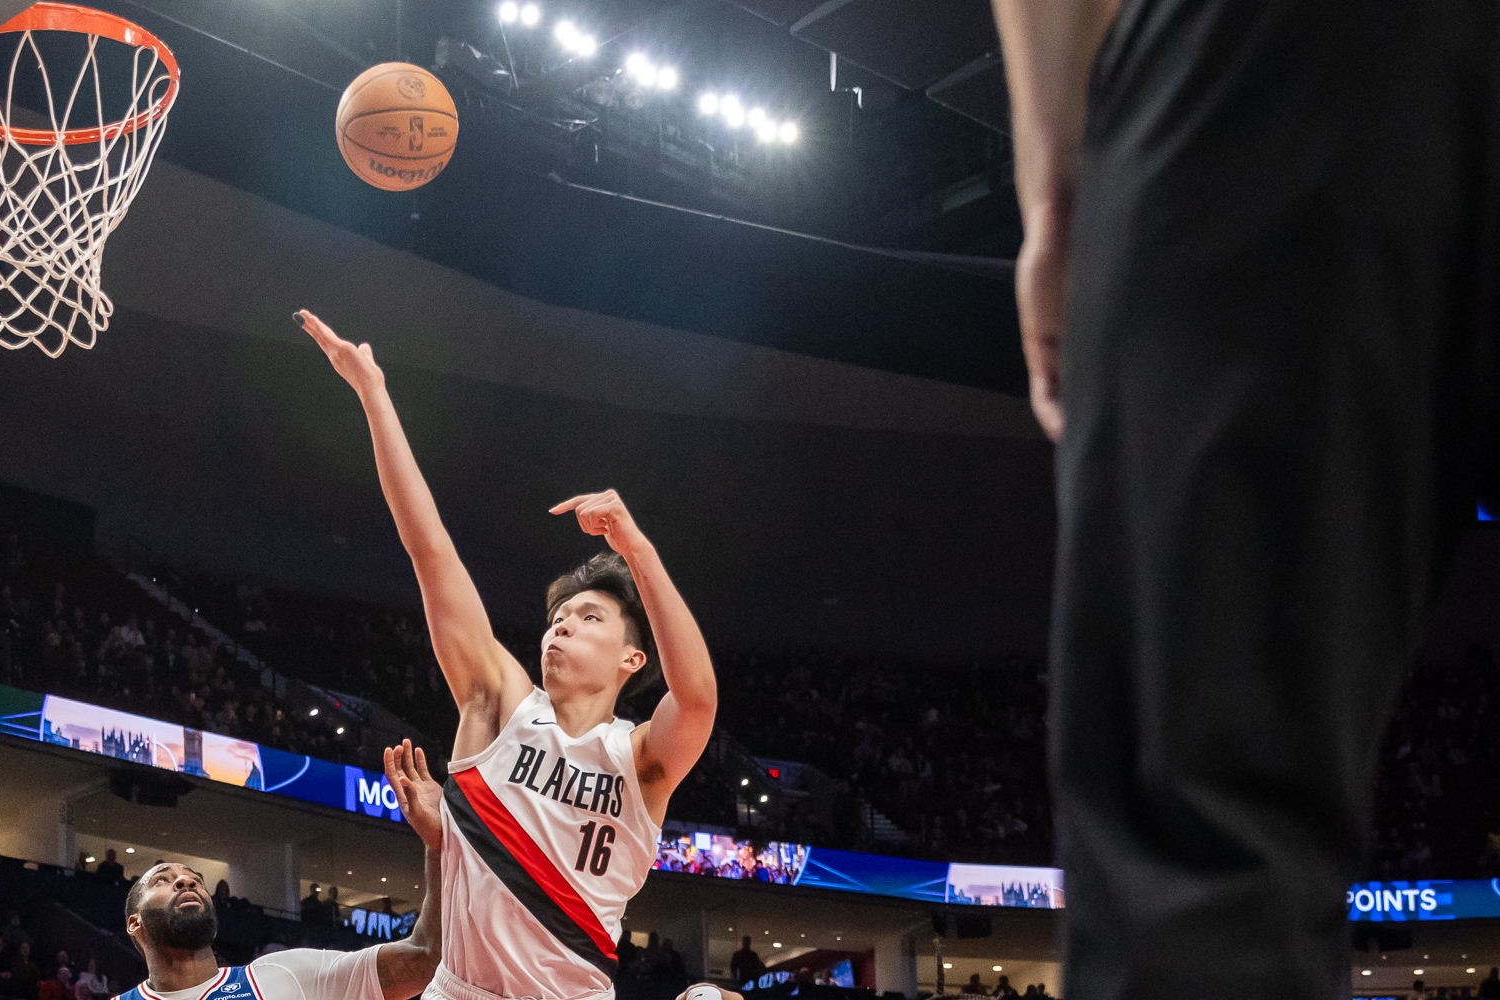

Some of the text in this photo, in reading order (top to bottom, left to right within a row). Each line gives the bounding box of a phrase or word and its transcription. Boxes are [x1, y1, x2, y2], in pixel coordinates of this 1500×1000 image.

[358, 778, 399, 810] MO
[508, 743, 624, 818] BLAZERS
[574, 820, 616, 877] 16
